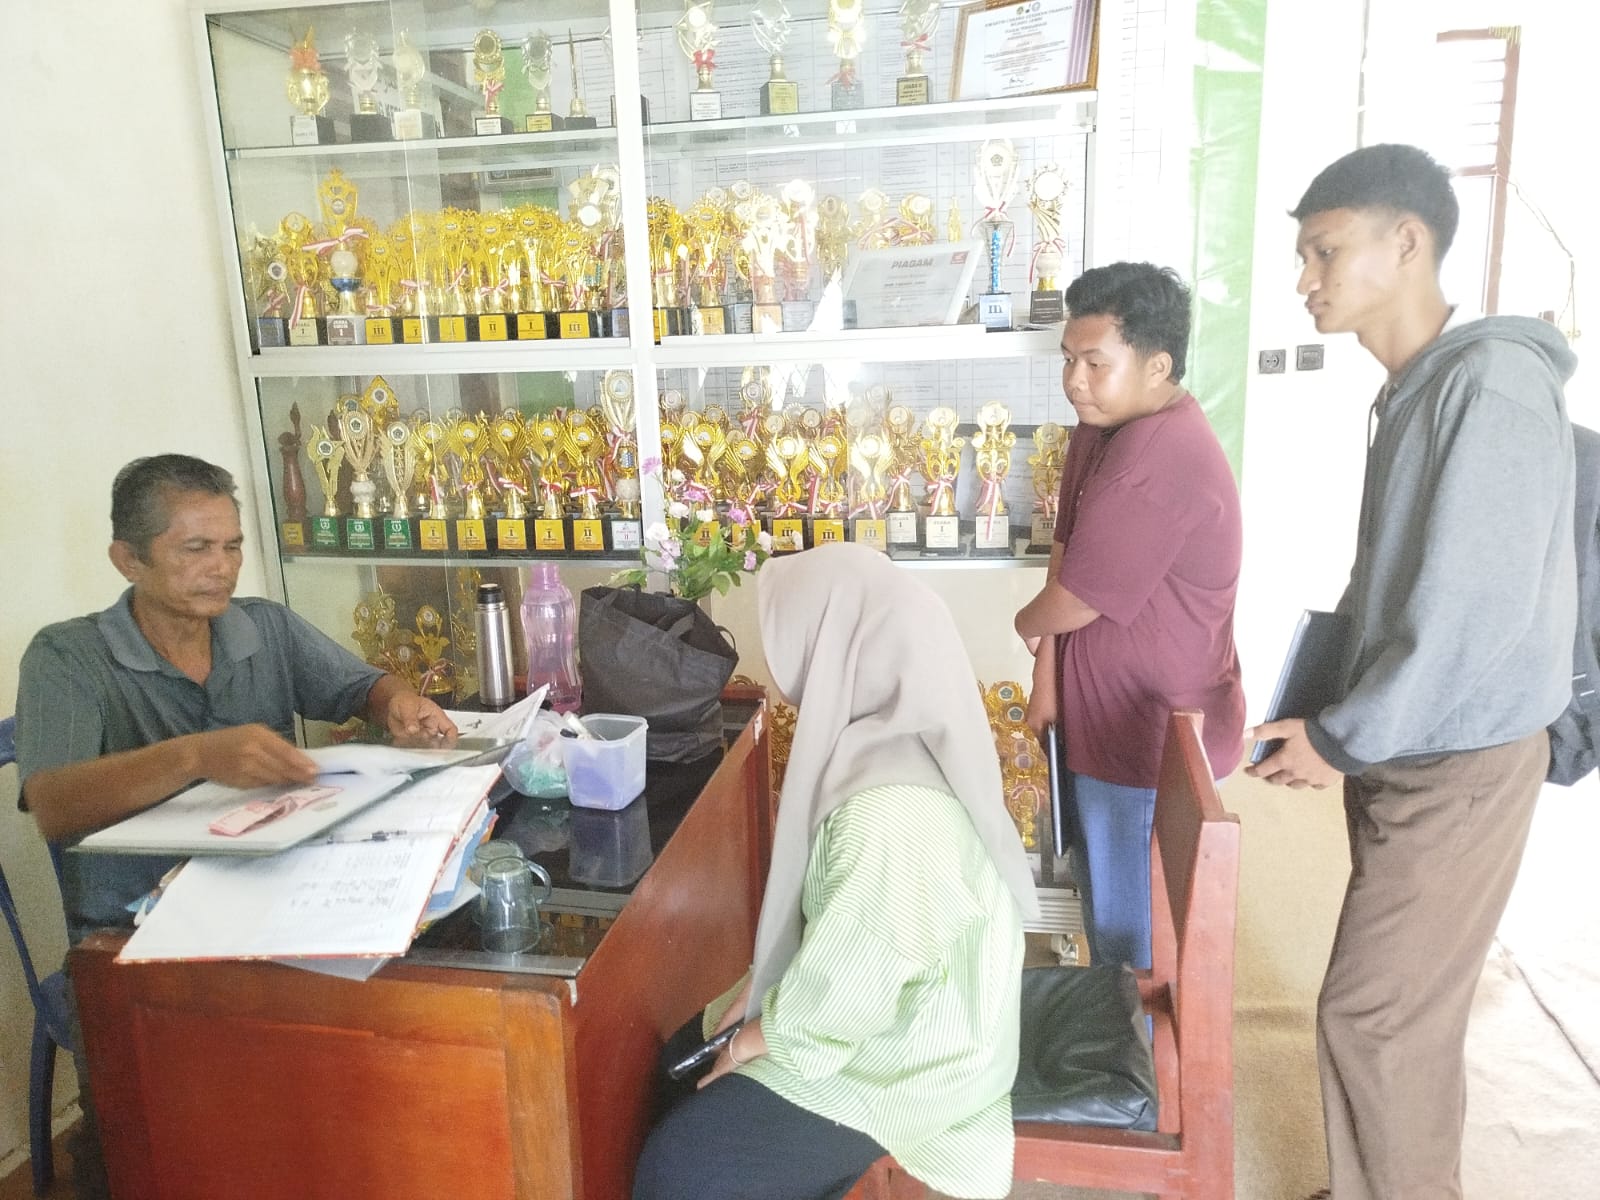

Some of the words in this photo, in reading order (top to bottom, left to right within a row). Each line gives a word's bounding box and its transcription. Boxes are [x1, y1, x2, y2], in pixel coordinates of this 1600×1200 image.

[891, 258, 934, 269] PIAGAM
[988, 304, 1003, 314] III
[373, 327, 385, 335] III
[488, 323, 497, 331] II
[569, 323, 581, 332] III
[584, 528, 593, 537] II
[822, 531, 835, 540] III
